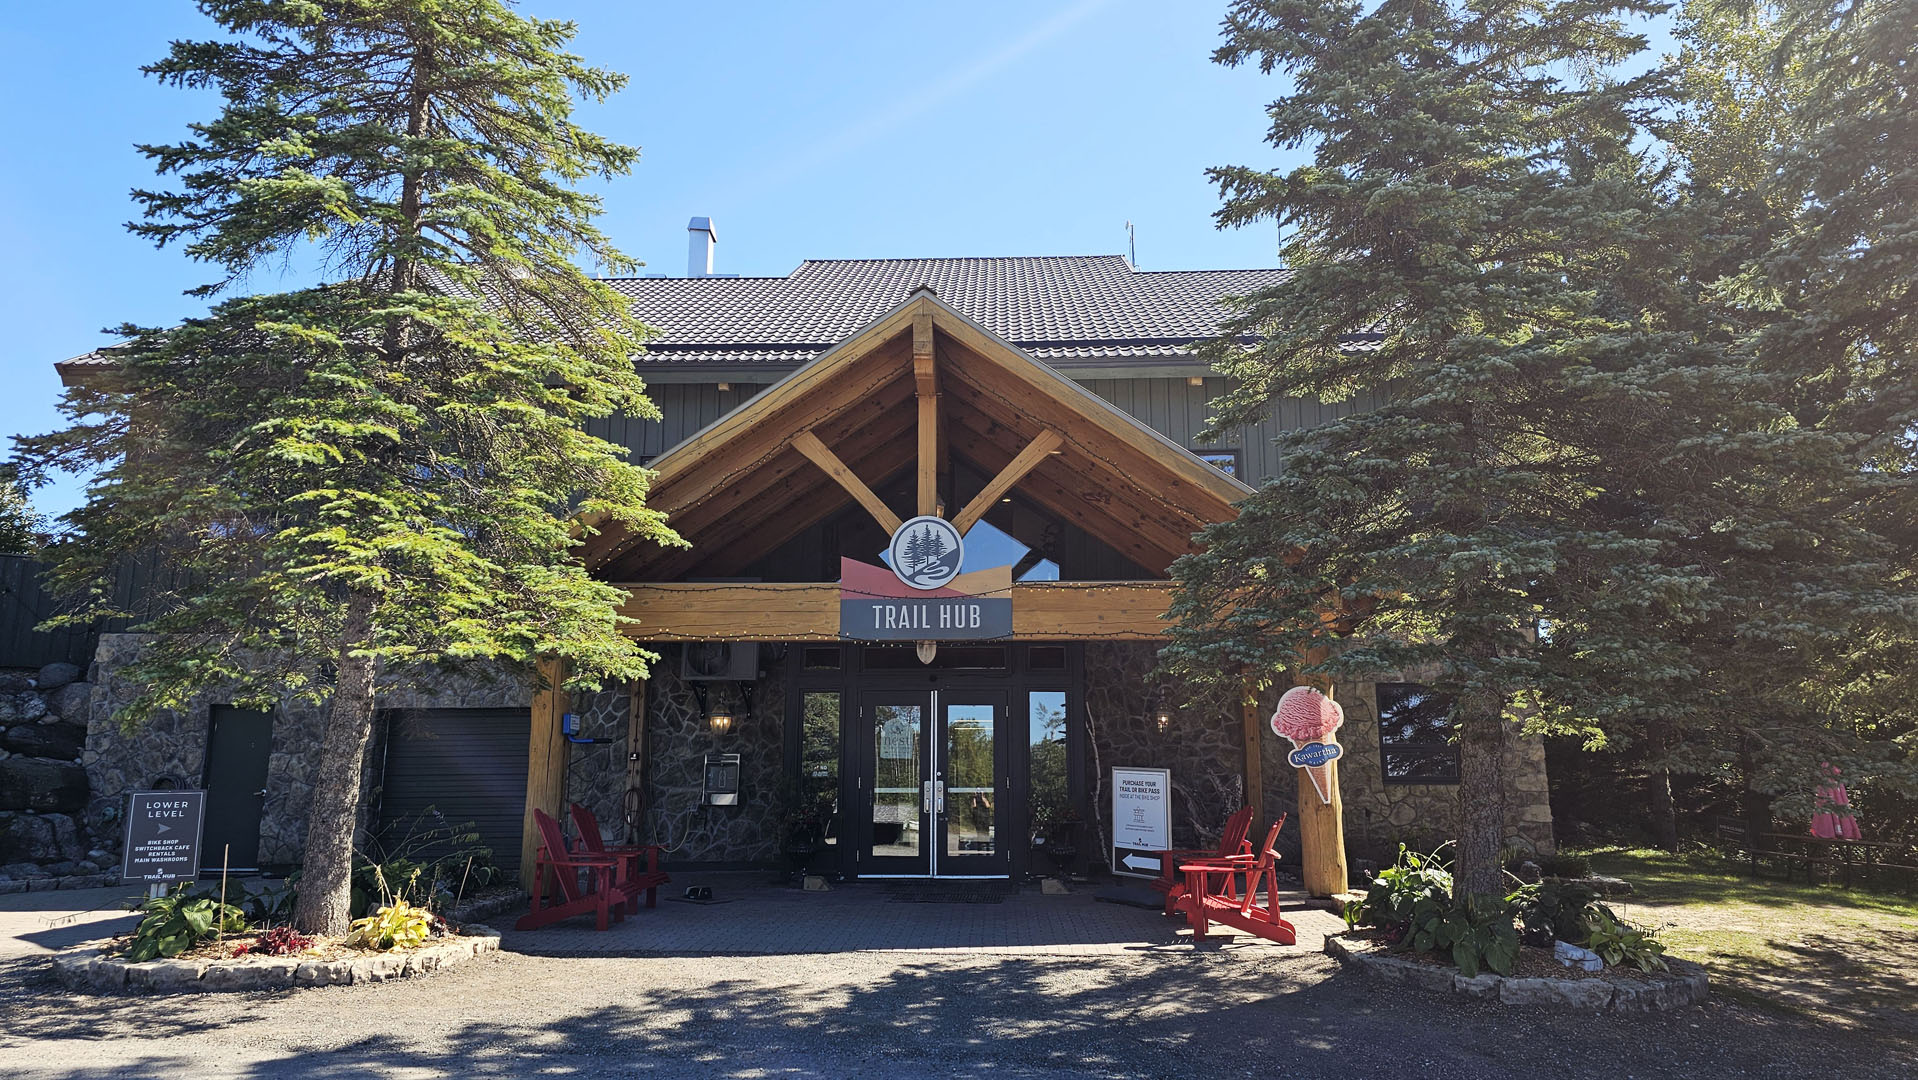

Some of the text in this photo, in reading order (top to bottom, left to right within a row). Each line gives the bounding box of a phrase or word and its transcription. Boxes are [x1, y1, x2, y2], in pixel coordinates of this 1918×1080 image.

[872, 604, 981, 629] TRAIL HUB
[1294, 747, 1337, 763] Kawartha
[146, 801, 189, 809] LOWER
[148, 810, 185, 818] LEVEL
